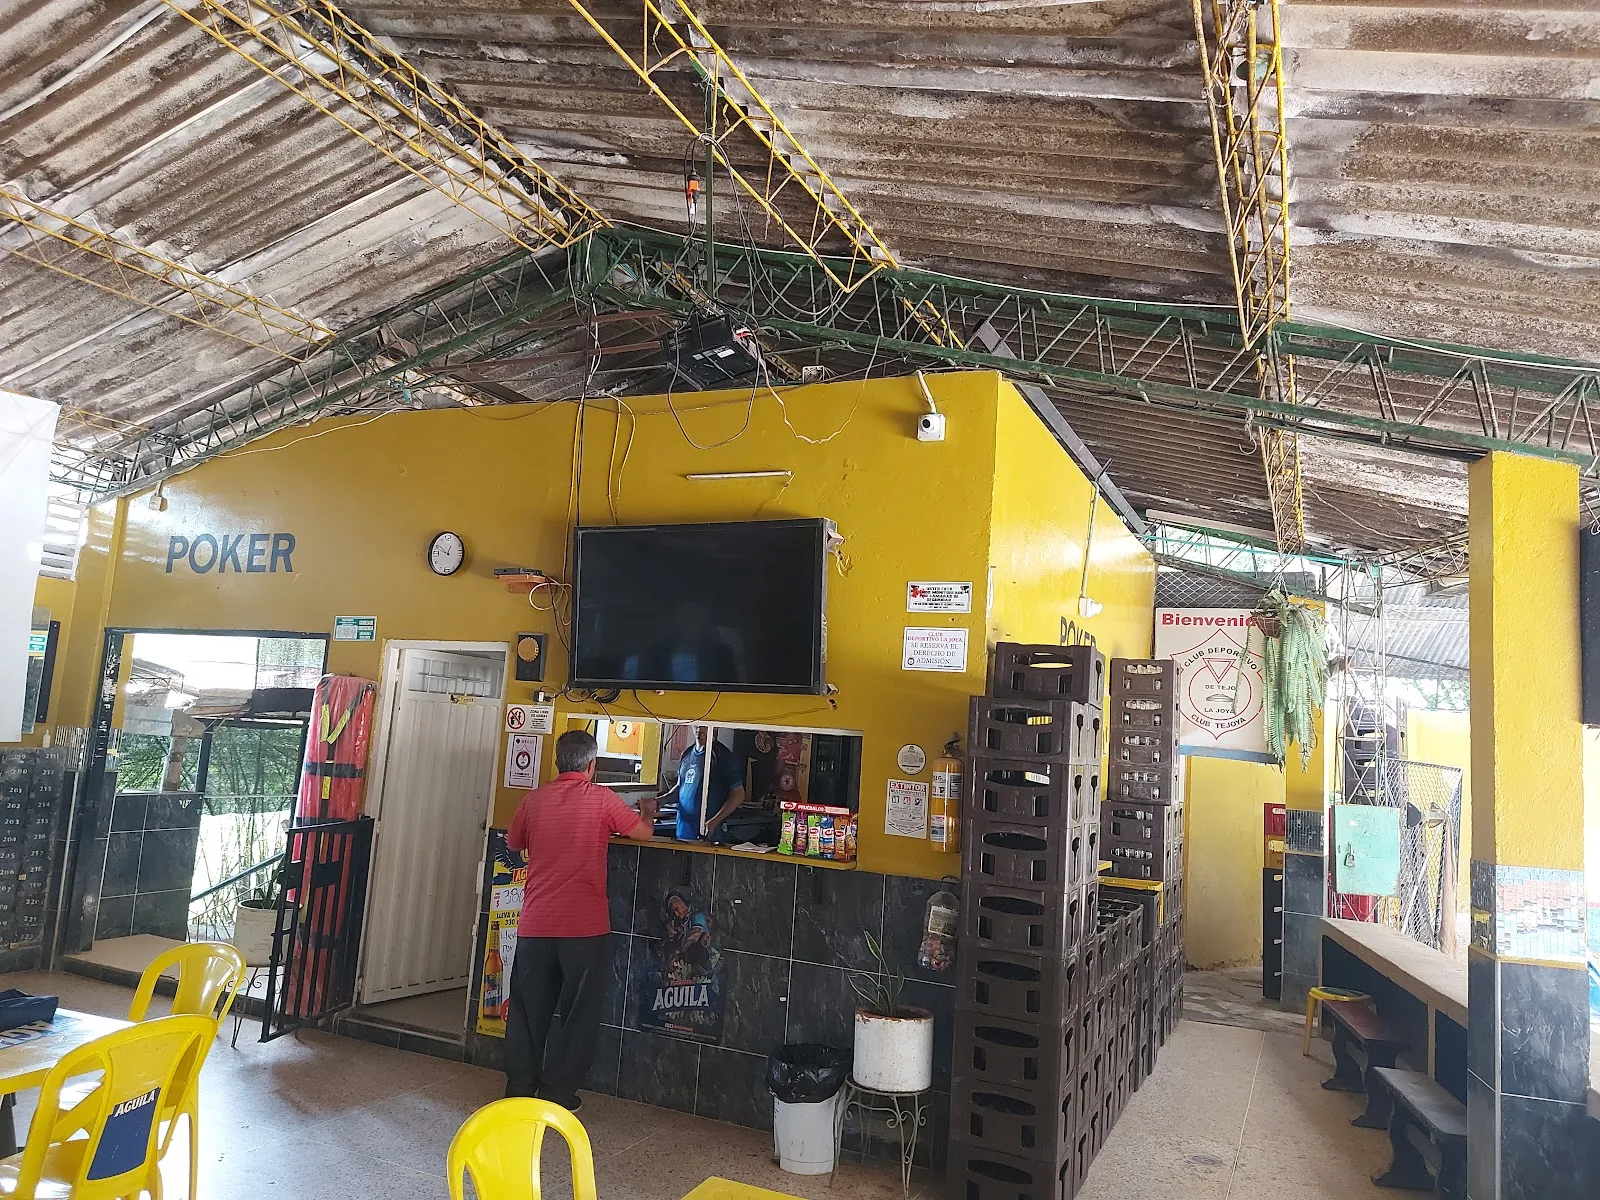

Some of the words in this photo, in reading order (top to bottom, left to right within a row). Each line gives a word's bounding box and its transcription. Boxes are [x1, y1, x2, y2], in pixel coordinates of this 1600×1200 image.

[165, 532, 296, 574] POKER
[1162, 613, 1257, 626] Bienvenid
[913, 649, 946, 657] DERECHO
[1184, 650, 1205, 668] CLUB
[1207, 647, 1258, 670] DEPORVO
[1191, 714, 1211, 727] CLUB
[1215, 717, 1247, 729] TEJOYA
[890, 782, 926, 792] EXTINTOR
[652, 984, 709, 1011] AGUILA
[114, 1090, 155, 1118] AGUILA
